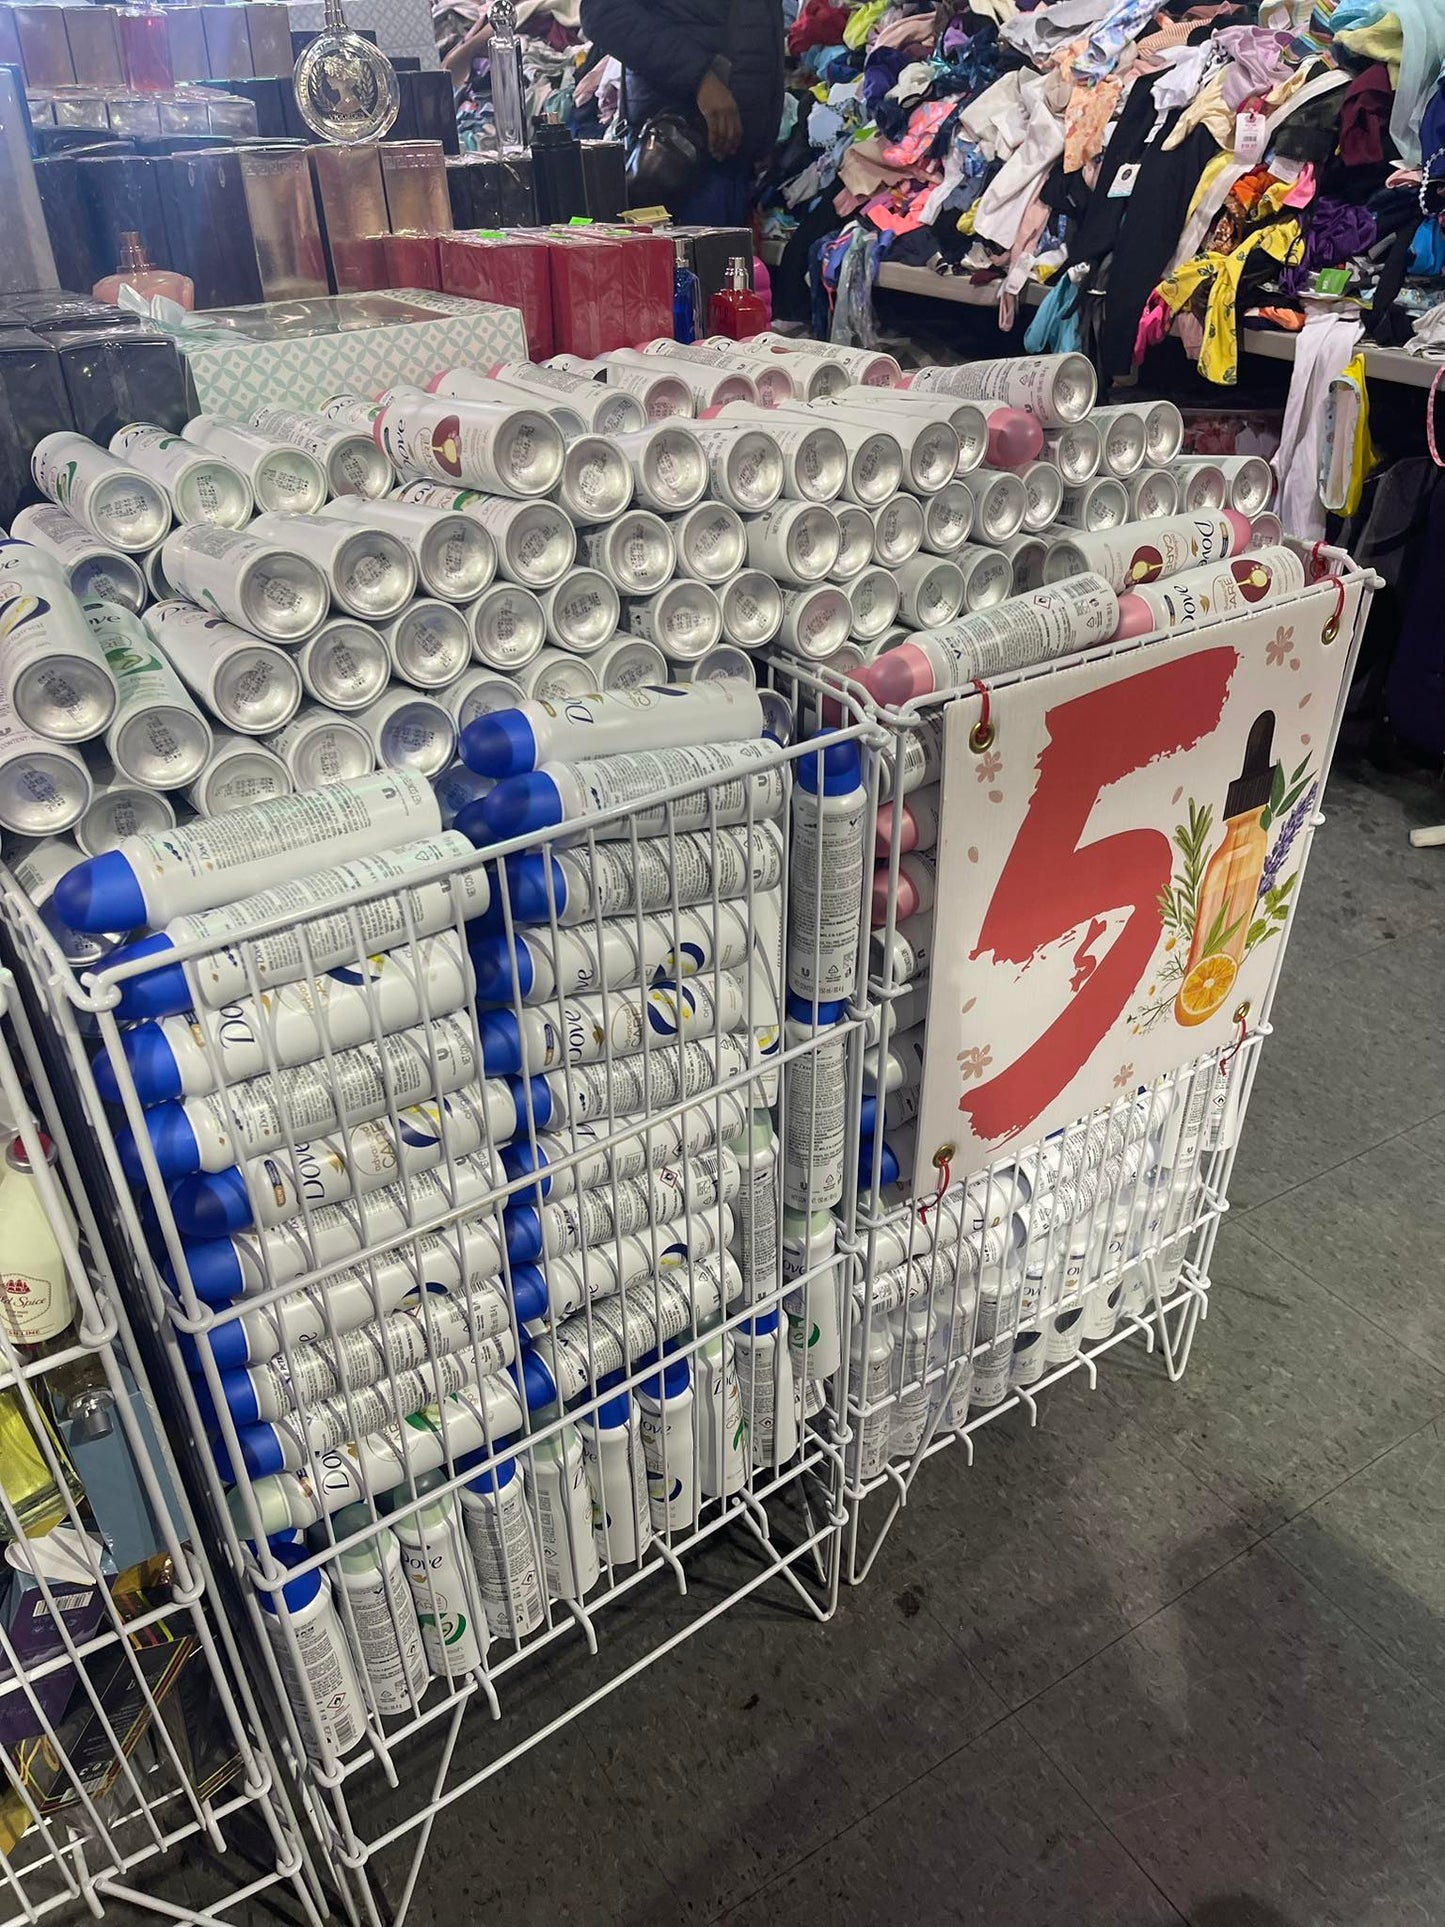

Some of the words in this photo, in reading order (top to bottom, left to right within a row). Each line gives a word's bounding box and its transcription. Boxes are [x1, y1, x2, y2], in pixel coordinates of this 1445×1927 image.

[1227, 577, 1237, 609] ARE
[960, 647, 1239, 1140] 5
[220, 1004, 255, 1049] Do
[13, 1296, 46, 1308] Spice
